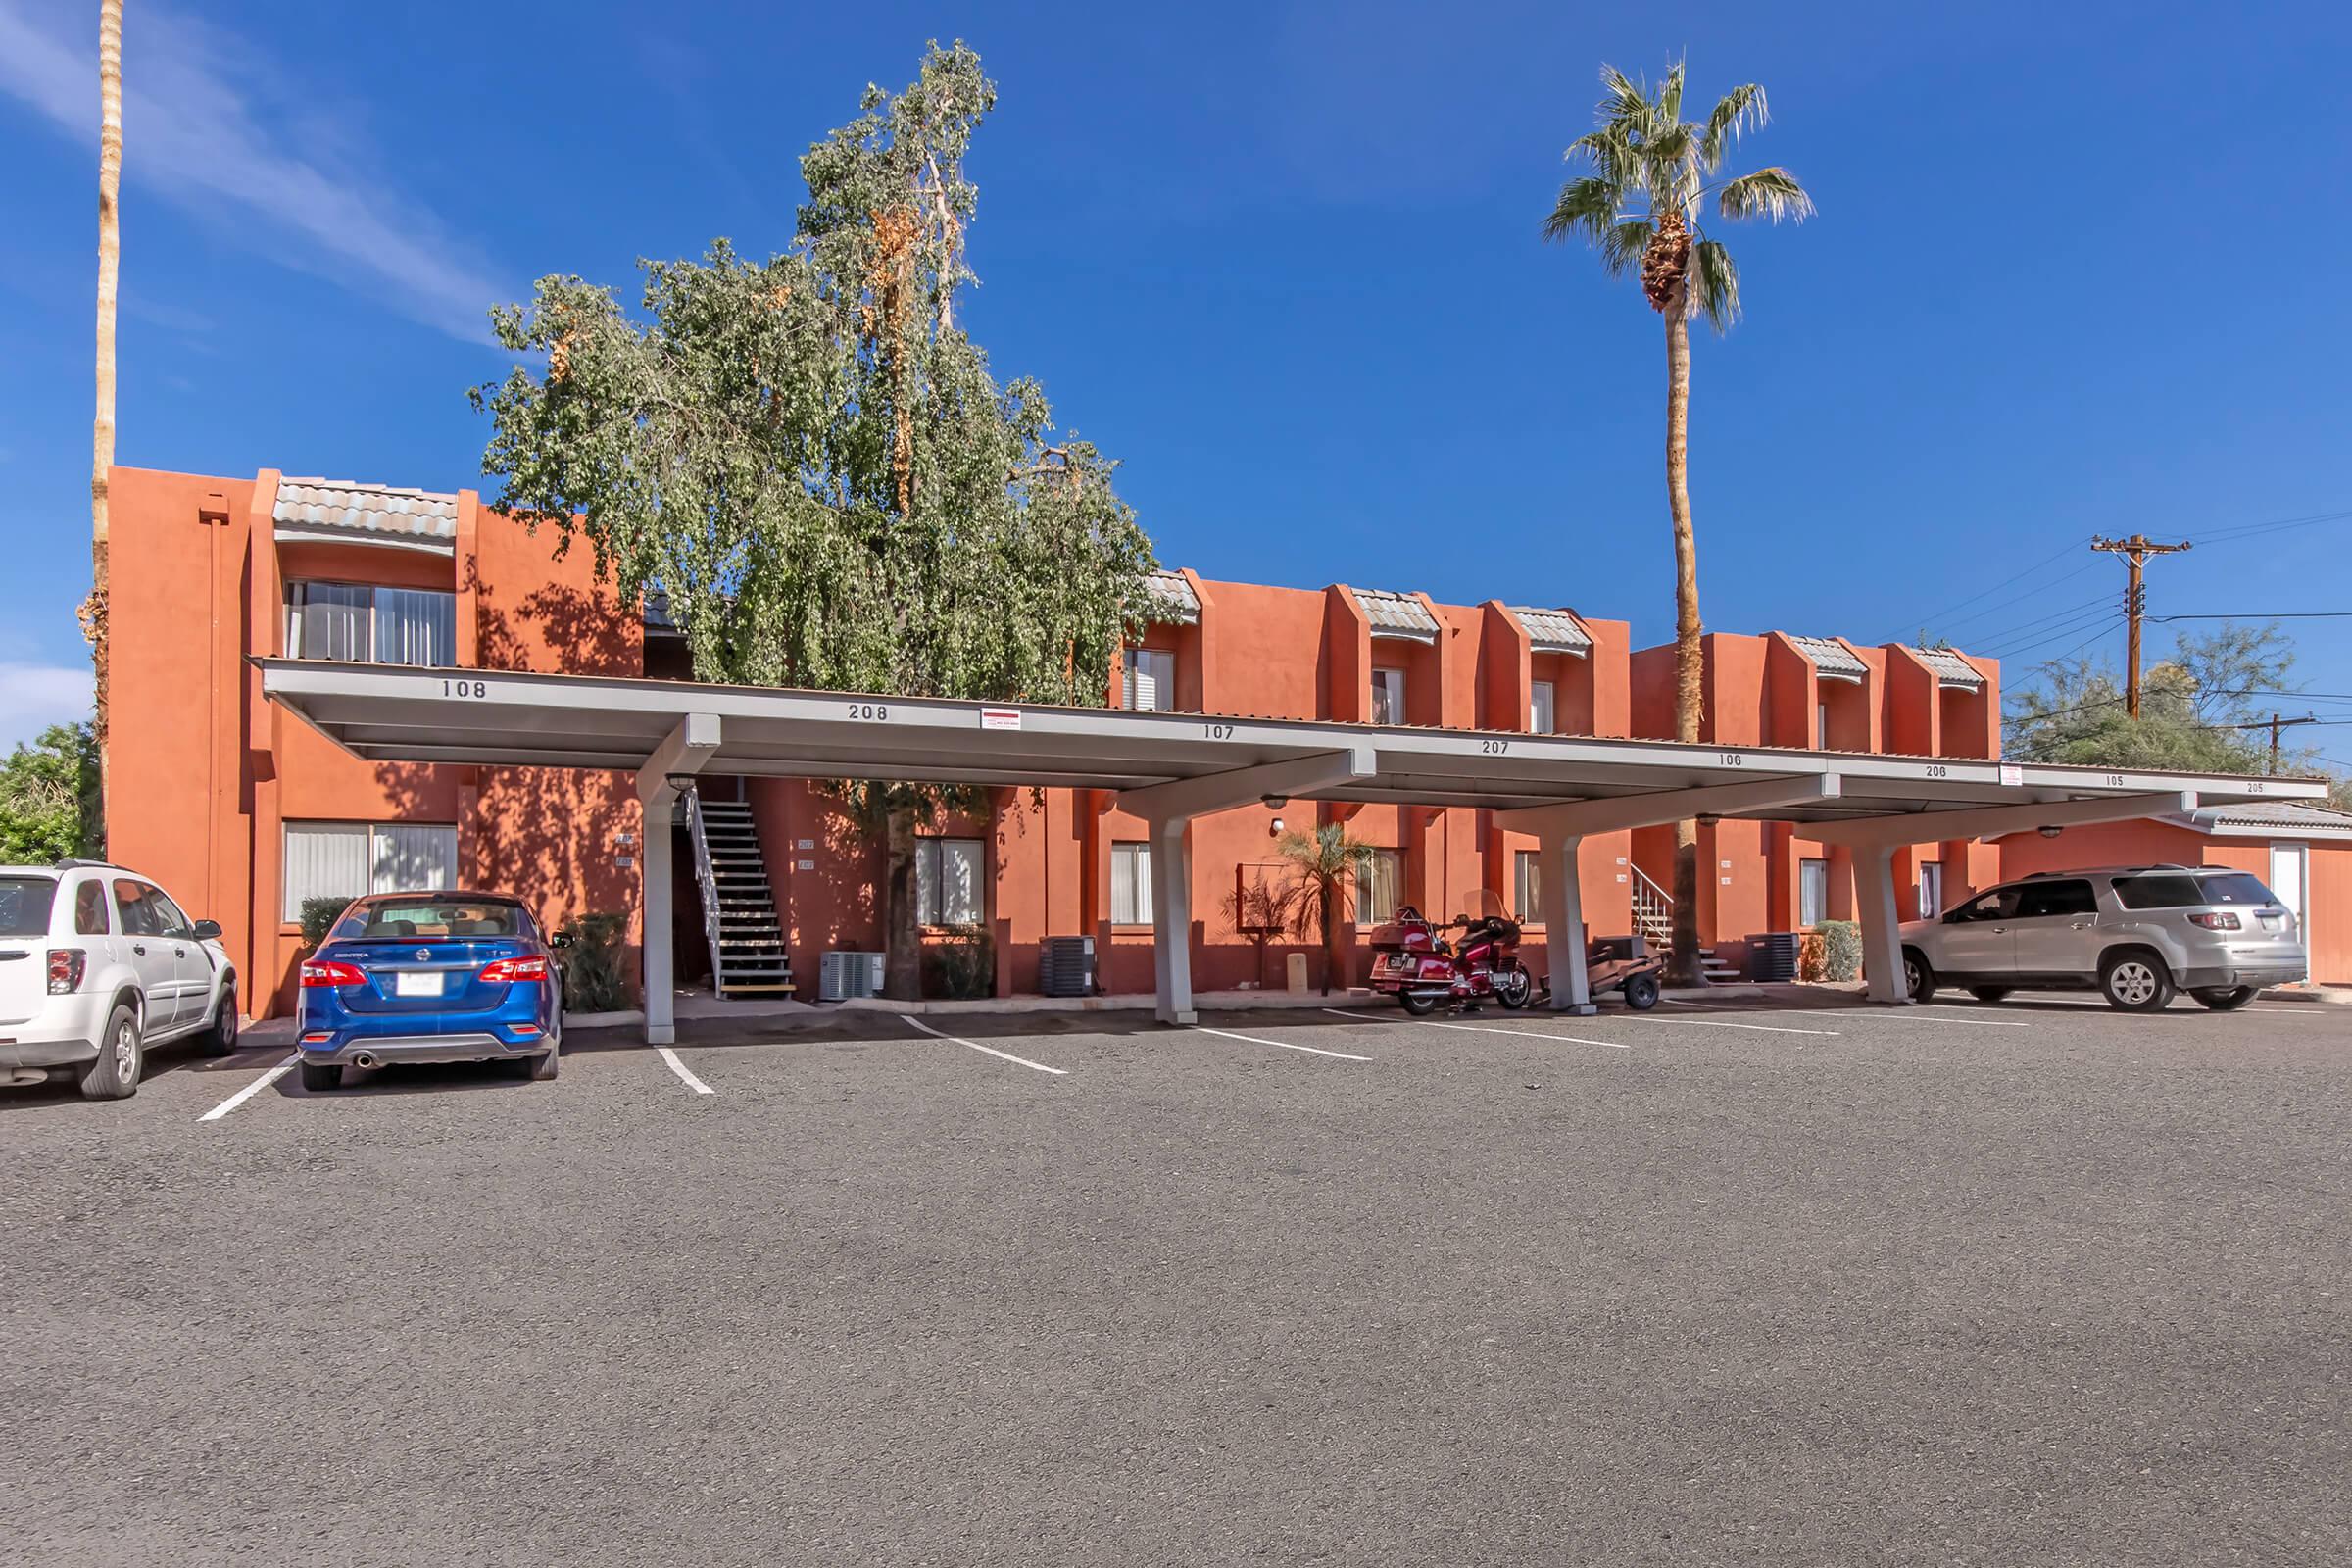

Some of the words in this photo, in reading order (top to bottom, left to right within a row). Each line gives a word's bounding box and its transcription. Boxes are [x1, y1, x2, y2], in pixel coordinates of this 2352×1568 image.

[443, 680, 486, 698] 108
[849, 704, 887, 720] 208
[1205, 724, 1234, 740] 107
[1482, 740, 1509, 754] 207
[1720, 754, 1741, 766] 106
[1926, 765, 1946, 777] 206
[2106, 775, 2124, 786] 105
[2247, 783, 2263, 793] 205
